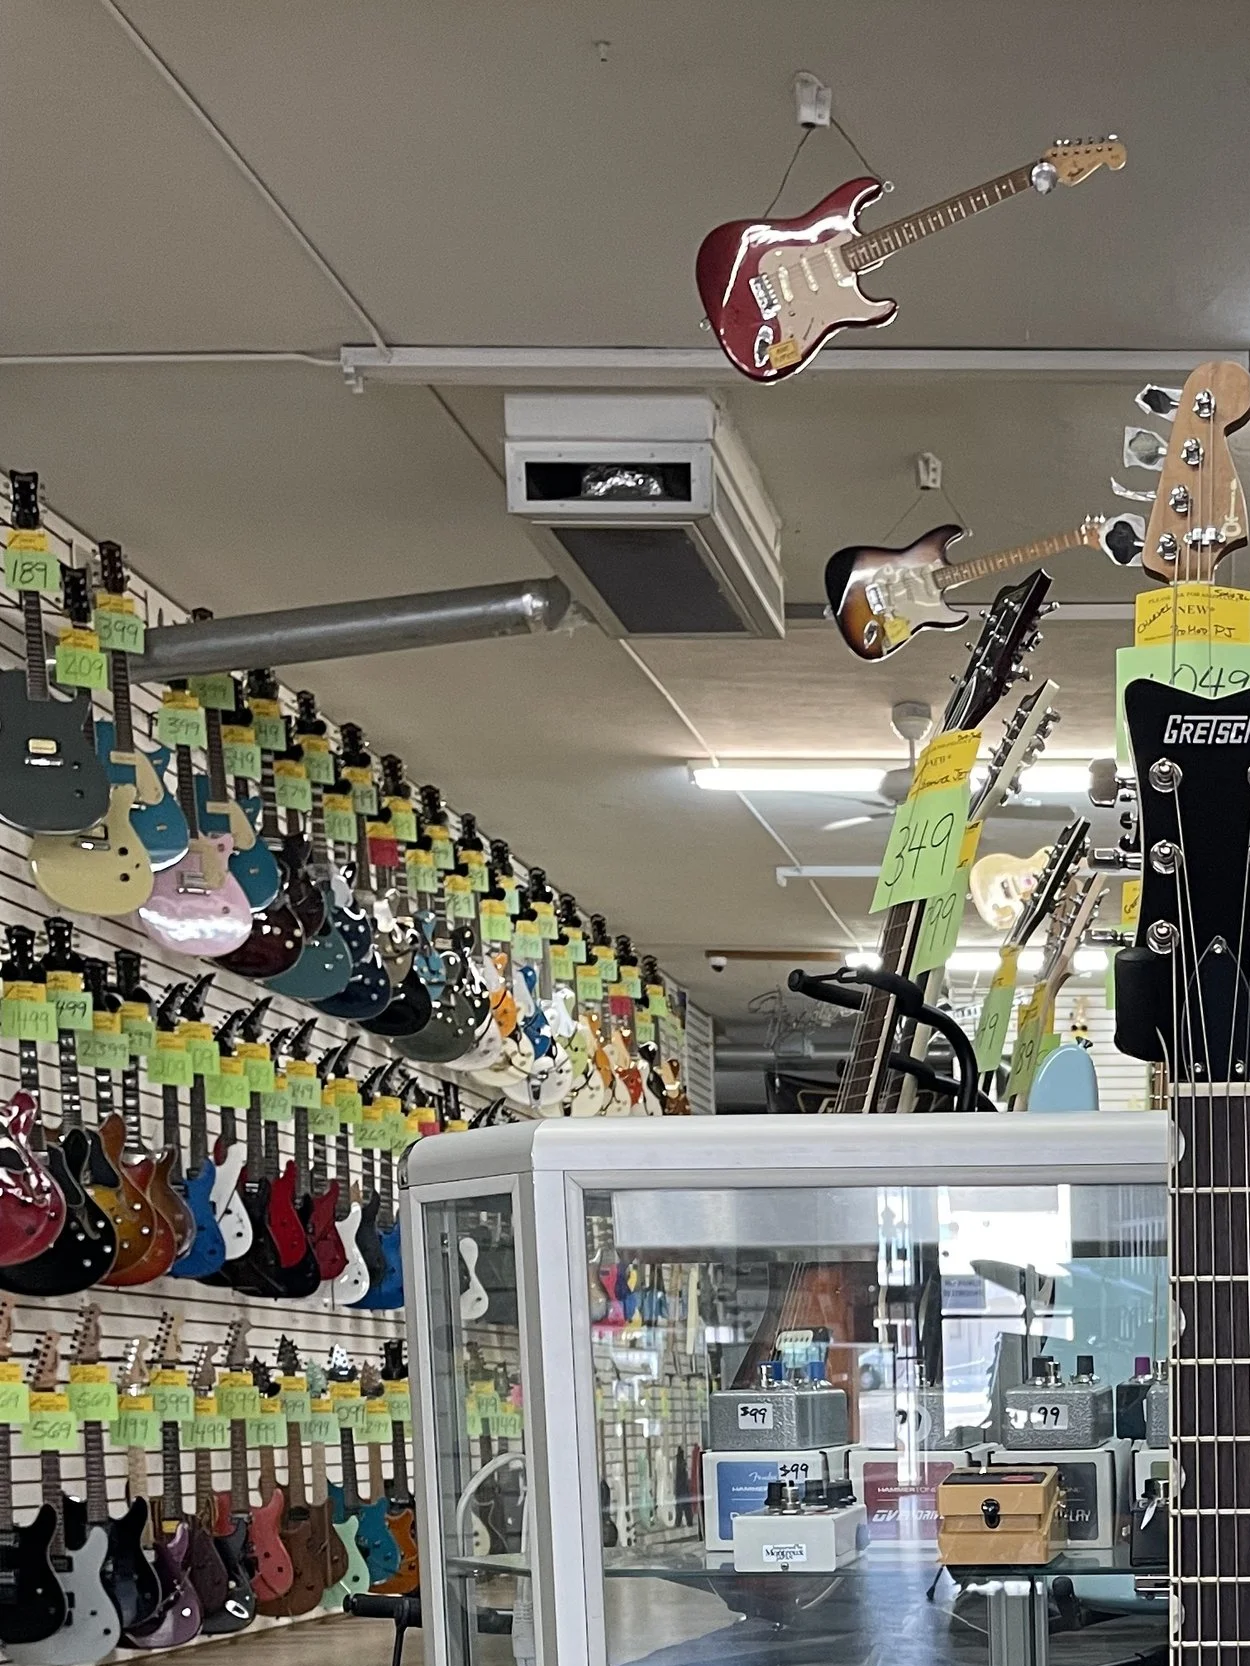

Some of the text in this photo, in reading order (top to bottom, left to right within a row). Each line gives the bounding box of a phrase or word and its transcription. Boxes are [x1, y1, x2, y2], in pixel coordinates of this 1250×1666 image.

[11, 558, 48, 589] 189
[884, 811, 956, 889] 349
[740, 1406, 768, 1425] $99
[31, 1419, 72, 1440] 569
[779, 1462, 810, 1481] $99
